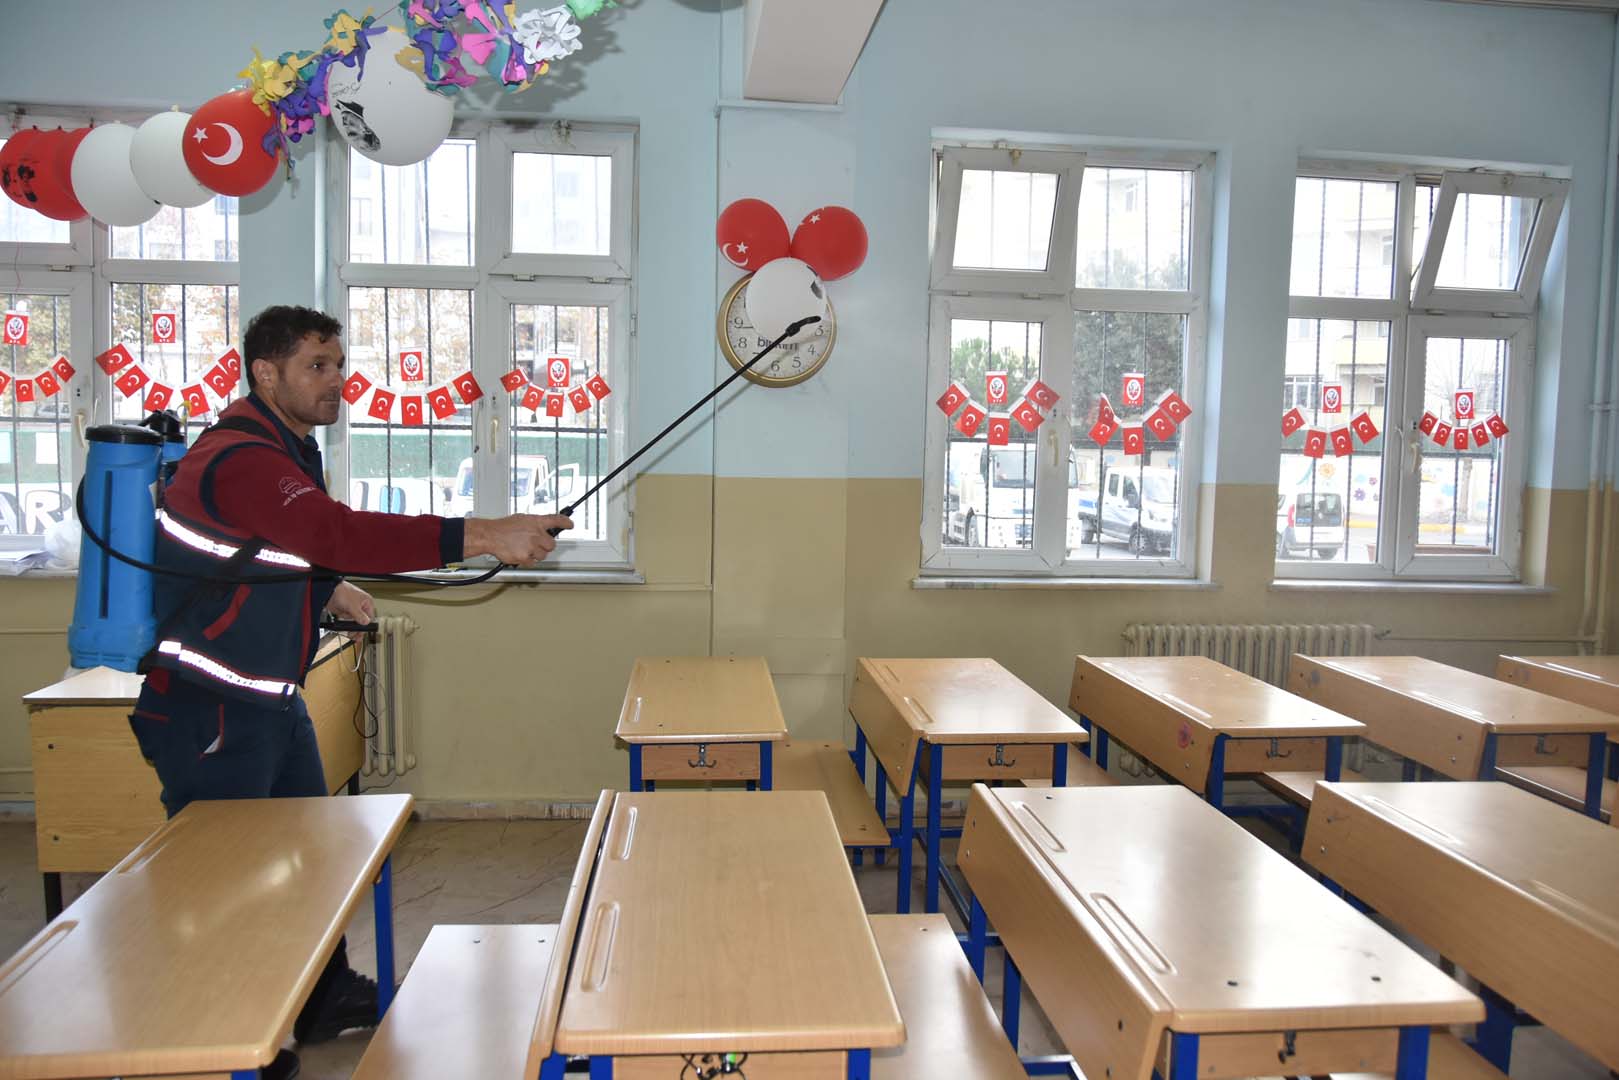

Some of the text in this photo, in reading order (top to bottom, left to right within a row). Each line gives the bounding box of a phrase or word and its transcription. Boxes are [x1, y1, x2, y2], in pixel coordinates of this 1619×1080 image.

[734, 317, 743, 329] 9
[738, 337, 747, 349] 8
[807, 344, 816, 355] 4
[770, 360, 780, 372] 6
[792, 357, 801, 368] 5
